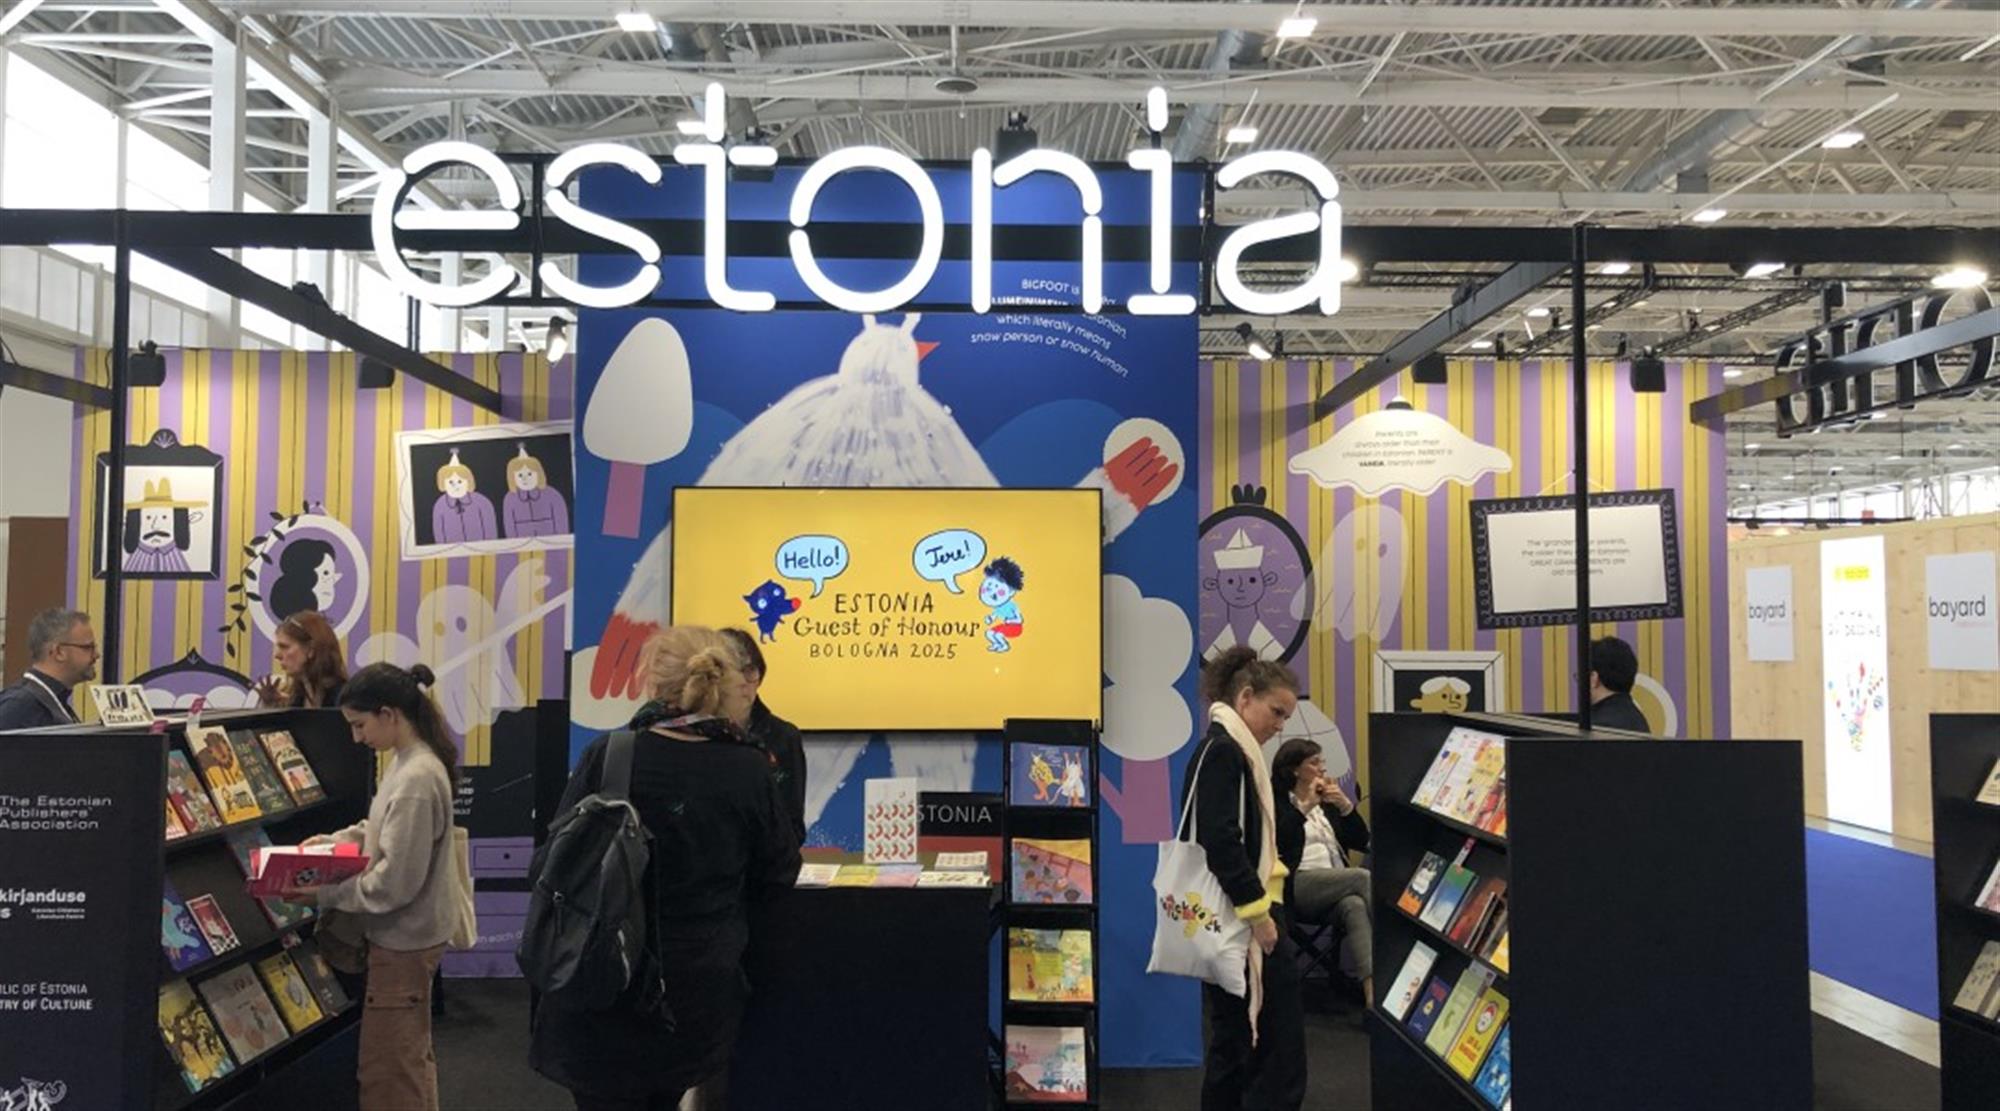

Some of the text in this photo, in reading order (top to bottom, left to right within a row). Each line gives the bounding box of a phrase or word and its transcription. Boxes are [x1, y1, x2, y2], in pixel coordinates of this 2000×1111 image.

[371, 83, 1343, 316] estonia
[1021, 279, 1069, 293] BIGFOOT
[997, 314, 1112, 351] which literally means
[971, 331, 1129, 378] snow person or snow human
[783, 545, 841, 570] Hello!
[835, 592, 935, 615] ESTONIA
[1749, 600, 1786, 623] bayard
[1929, 594, 1986, 623] bayard
[793, 616, 981, 639] Guest of Honour
[809, 642, 958, 659] BOLOGNA 2025
[0, 795, 112, 806] The Estonian
[0, 818, 99, 830] Association
[916, 804, 993, 823] STONIA
[0, 888, 86, 906] kirjanduse
[0, 984, 19, 995] LIC
[40, 981, 88, 995] ESTONIA
[40, 996, 94, 1010] CULTURE
